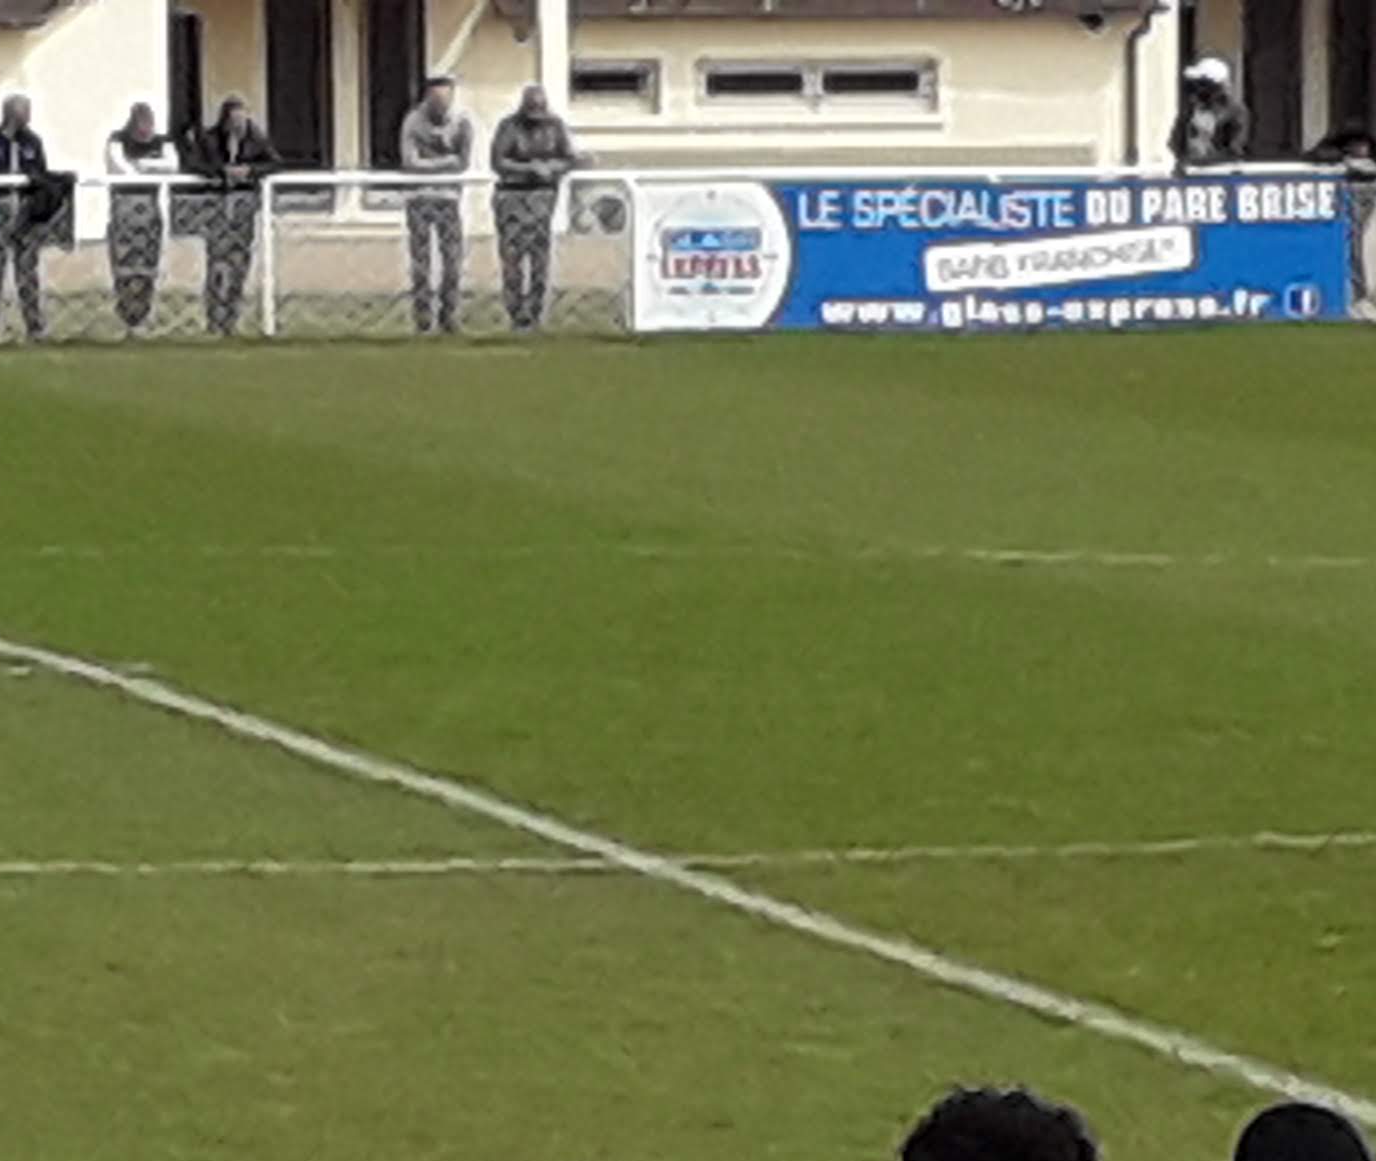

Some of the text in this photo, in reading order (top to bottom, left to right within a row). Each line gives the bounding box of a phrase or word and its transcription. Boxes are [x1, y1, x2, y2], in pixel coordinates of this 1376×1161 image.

[797, 182, 1337, 230] LE SPÉCIALISTE DU PARE BRISE
